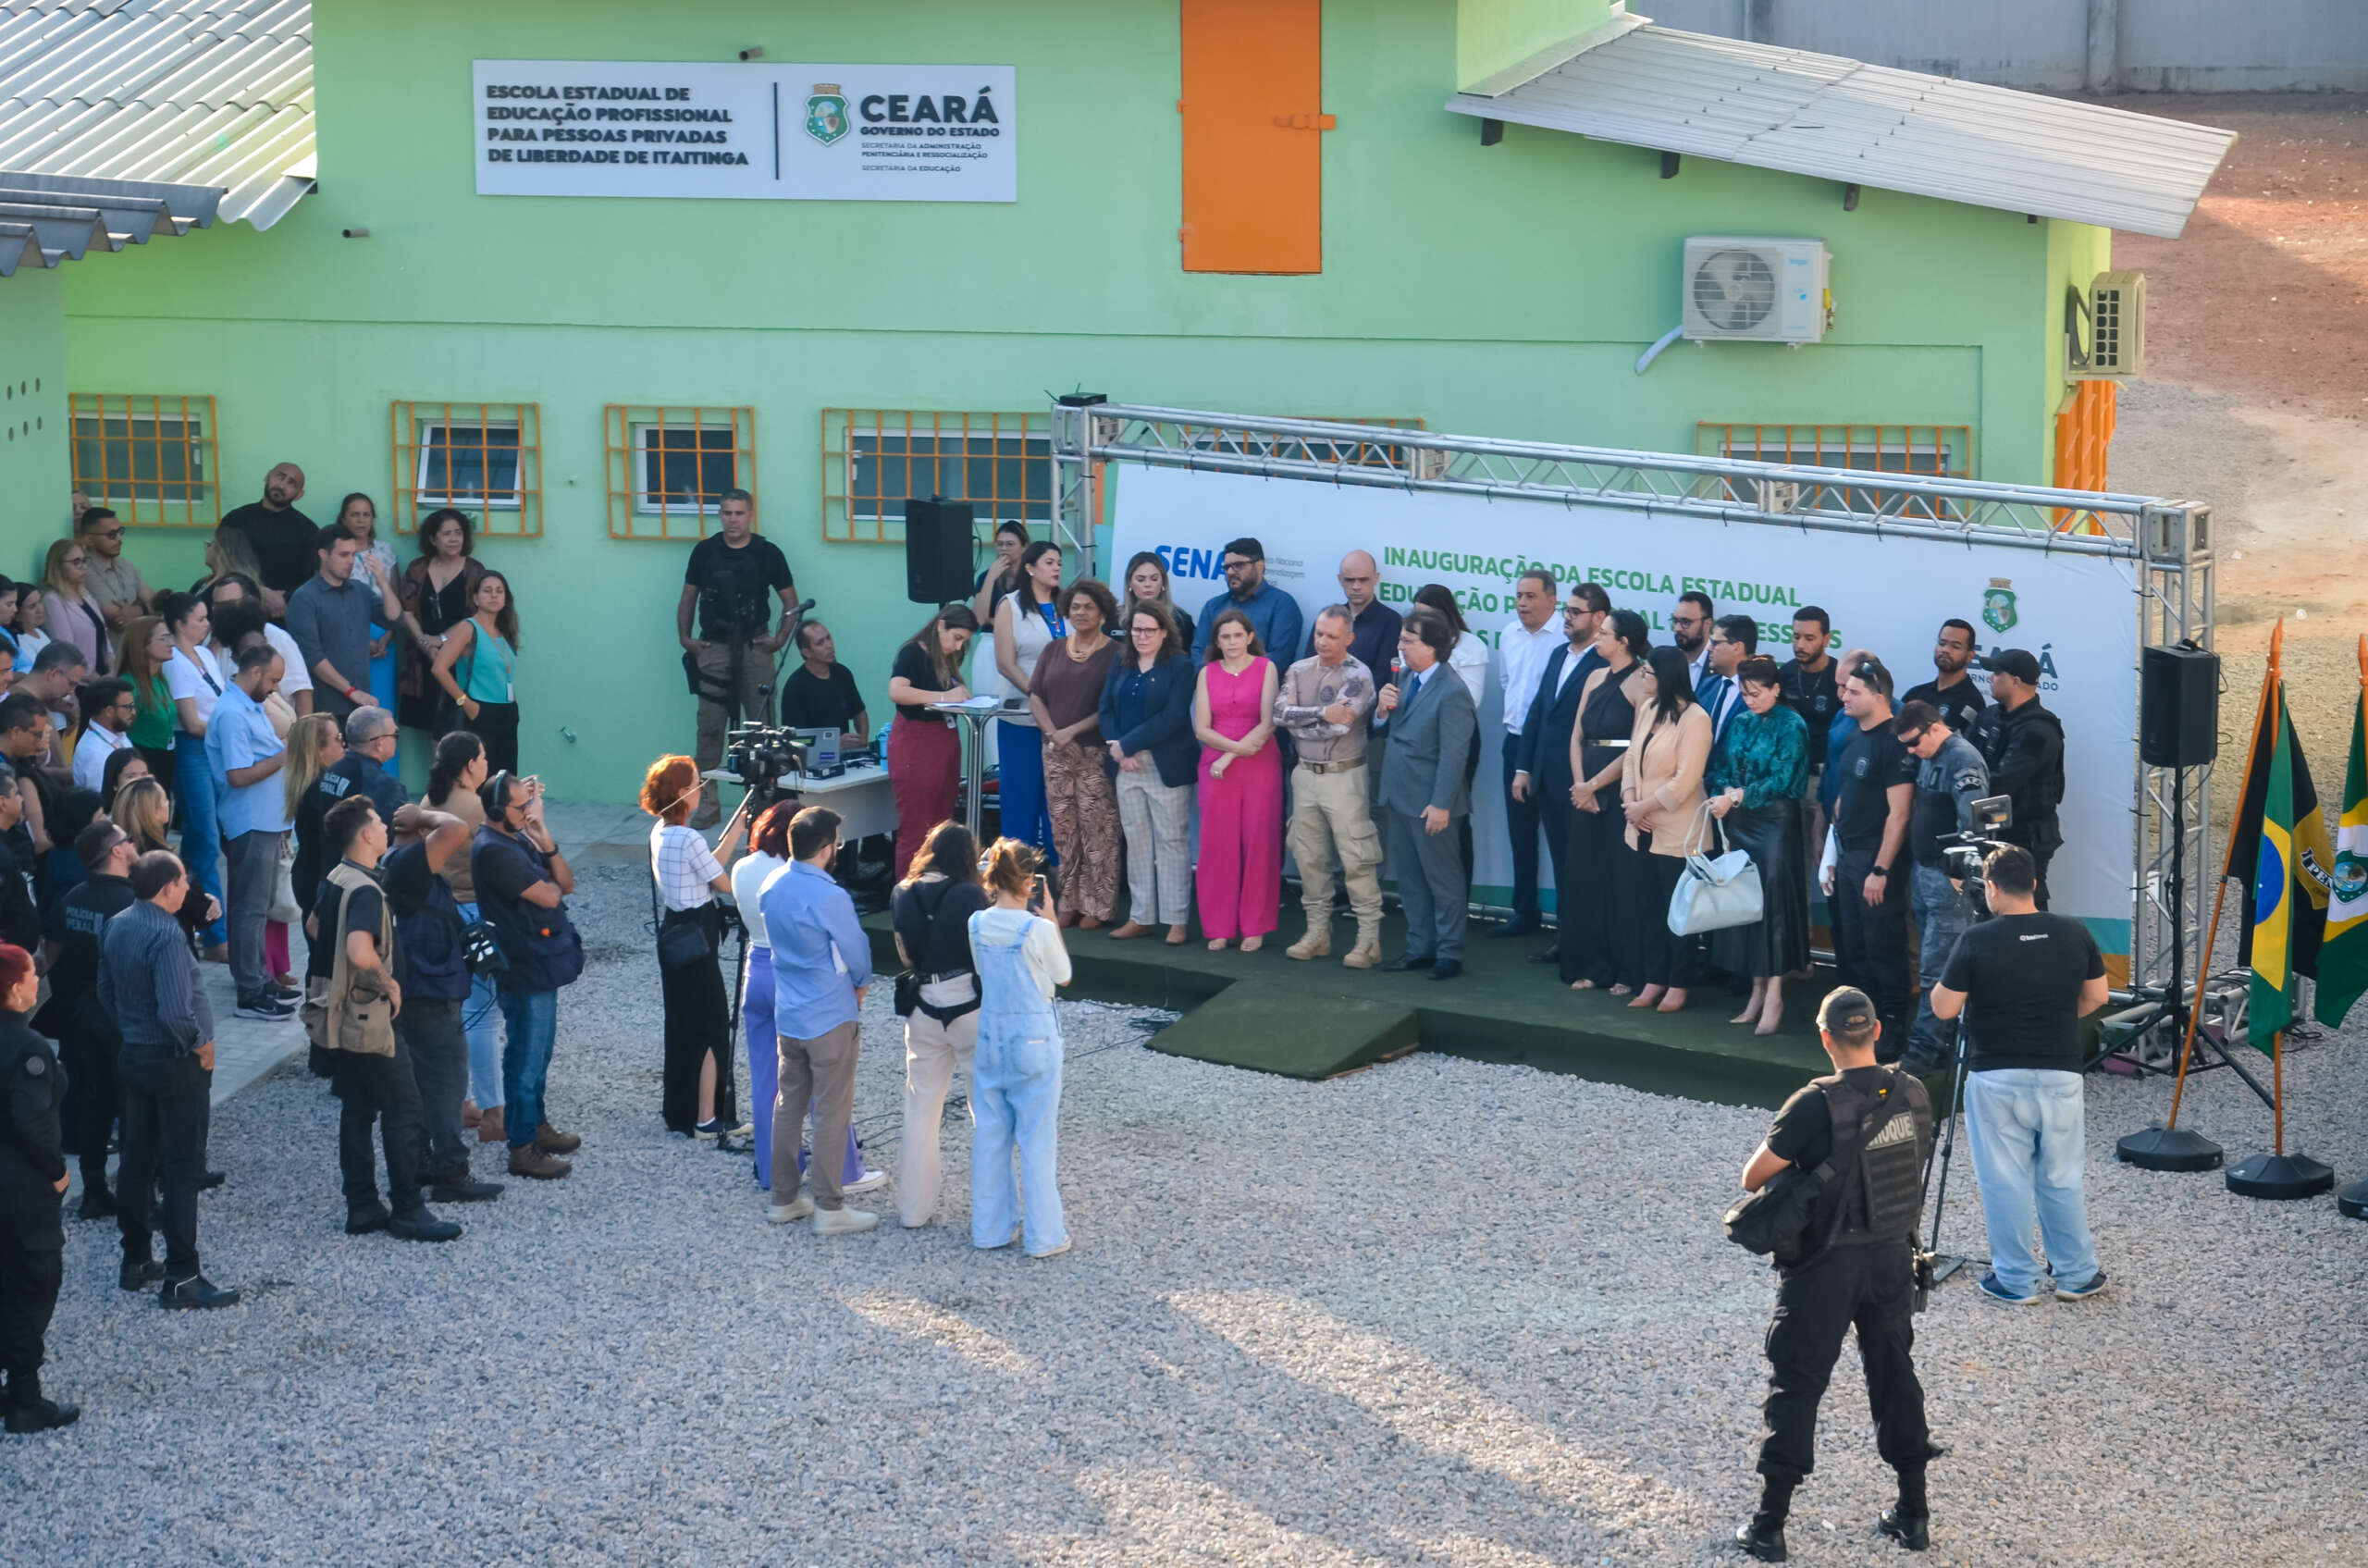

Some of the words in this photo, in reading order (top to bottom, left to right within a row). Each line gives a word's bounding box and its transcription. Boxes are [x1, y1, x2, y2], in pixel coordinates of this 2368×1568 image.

[487, 85, 560, 99] ESCOLA
[562, 86, 661, 100] ESTADUAL
[665, 88, 690, 101] DE
[860, 85, 999, 124] CEARÁ
[487, 103, 592, 126] EDUCAÇÃO
[596, 107, 733, 122] PROFISSIONAL
[487, 128, 538, 141] PARA
[542, 129, 627, 142] PESSOAS
[632, 130, 727, 143] PRIVADAS
[860, 127, 923, 136] GOVERNO
[927, 127, 946, 136] DO
[949, 127, 1000, 137] ESTADO
[919, 142, 981, 152] ADMINISTRAÇÃO
[487, 149, 512, 162] DE
[517, 149, 620, 164] LIBERDADE
[624, 150, 648, 164] DE
[653, 151, 749, 165] ITAITINGA
[922, 151, 988, 160] RESSOCIALIZAÇÃO
[919, 165, 961, 174] EDUCAÇÃO
[1154, 545, 1227, 580] SENA
[1551, 563, 1581, 585] DA
[1587, 566, 1675, 595] ESCOLA
[1681, 576, 1803, 608] ESTADUAL
[1379, 581, 1498, 616] EDUÇÃO
[1755, 621, 1843, 649] ESSS
